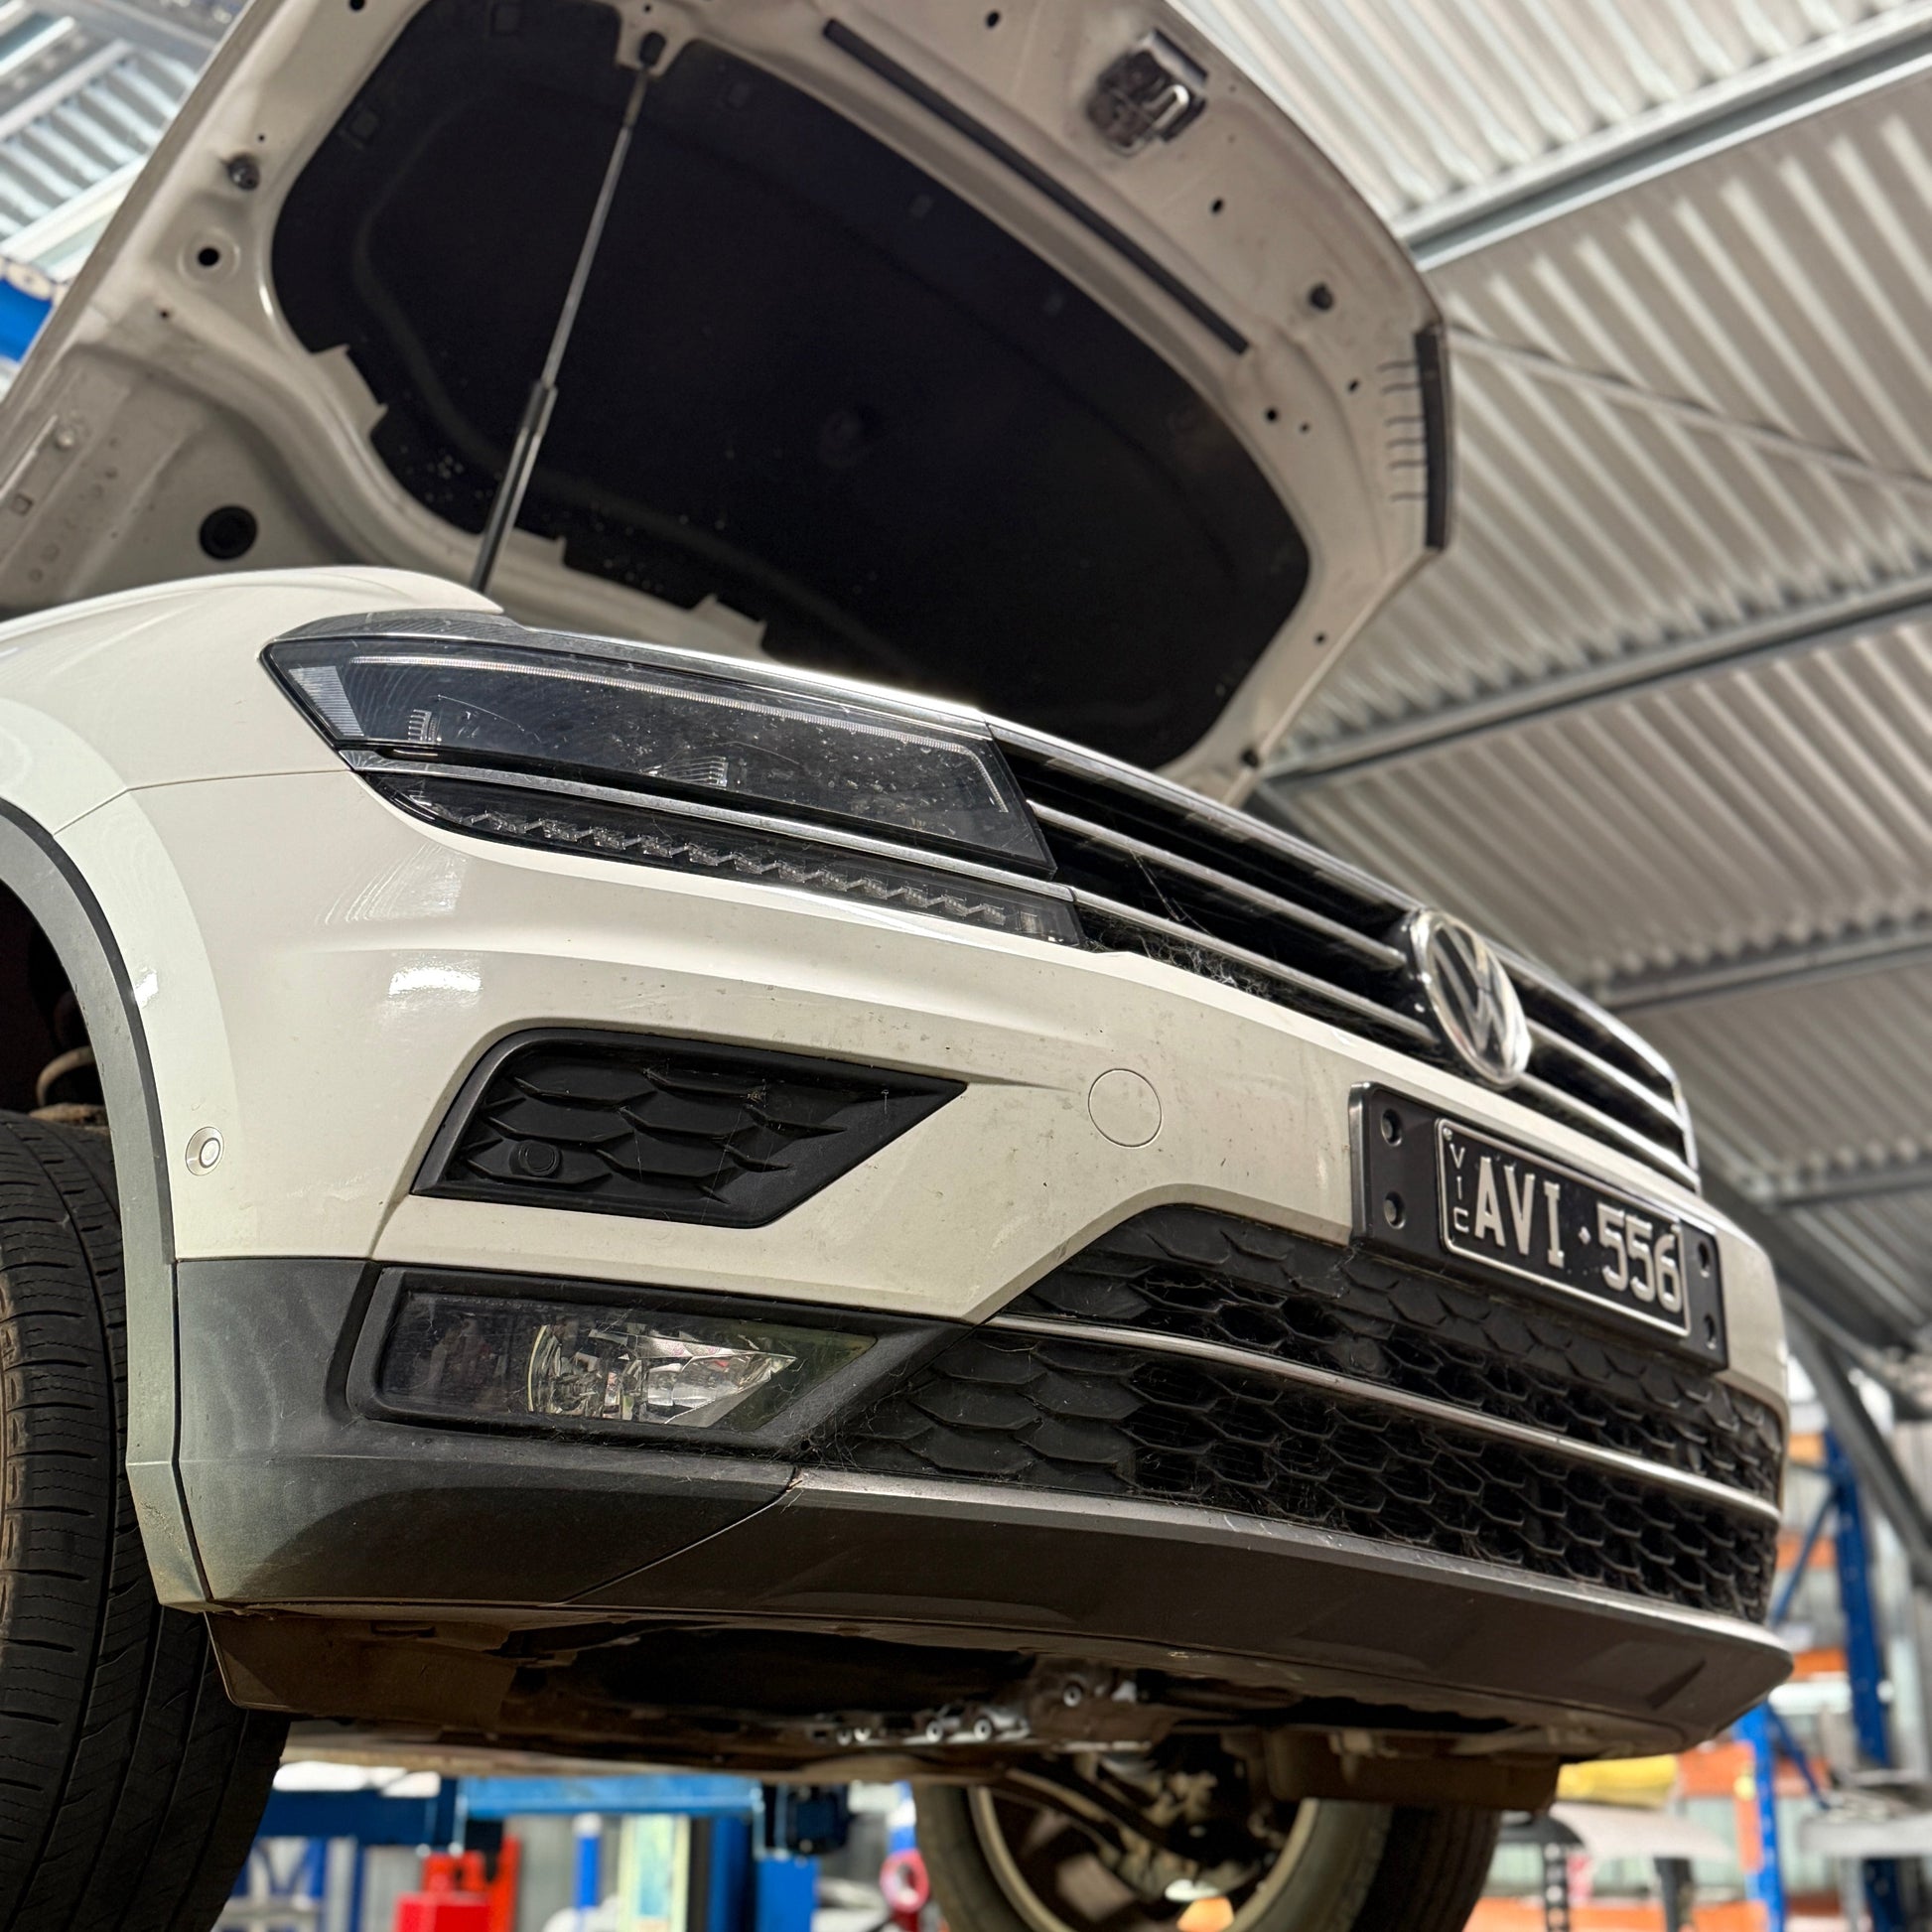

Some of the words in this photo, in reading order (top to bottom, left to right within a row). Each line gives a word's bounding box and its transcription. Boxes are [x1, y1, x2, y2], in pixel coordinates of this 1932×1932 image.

[1449, 1143, 1469, 1233] VIC
[1474, 1156, 1565, 1269] AVI
[1596, 1202, 1684, 1313] 556
